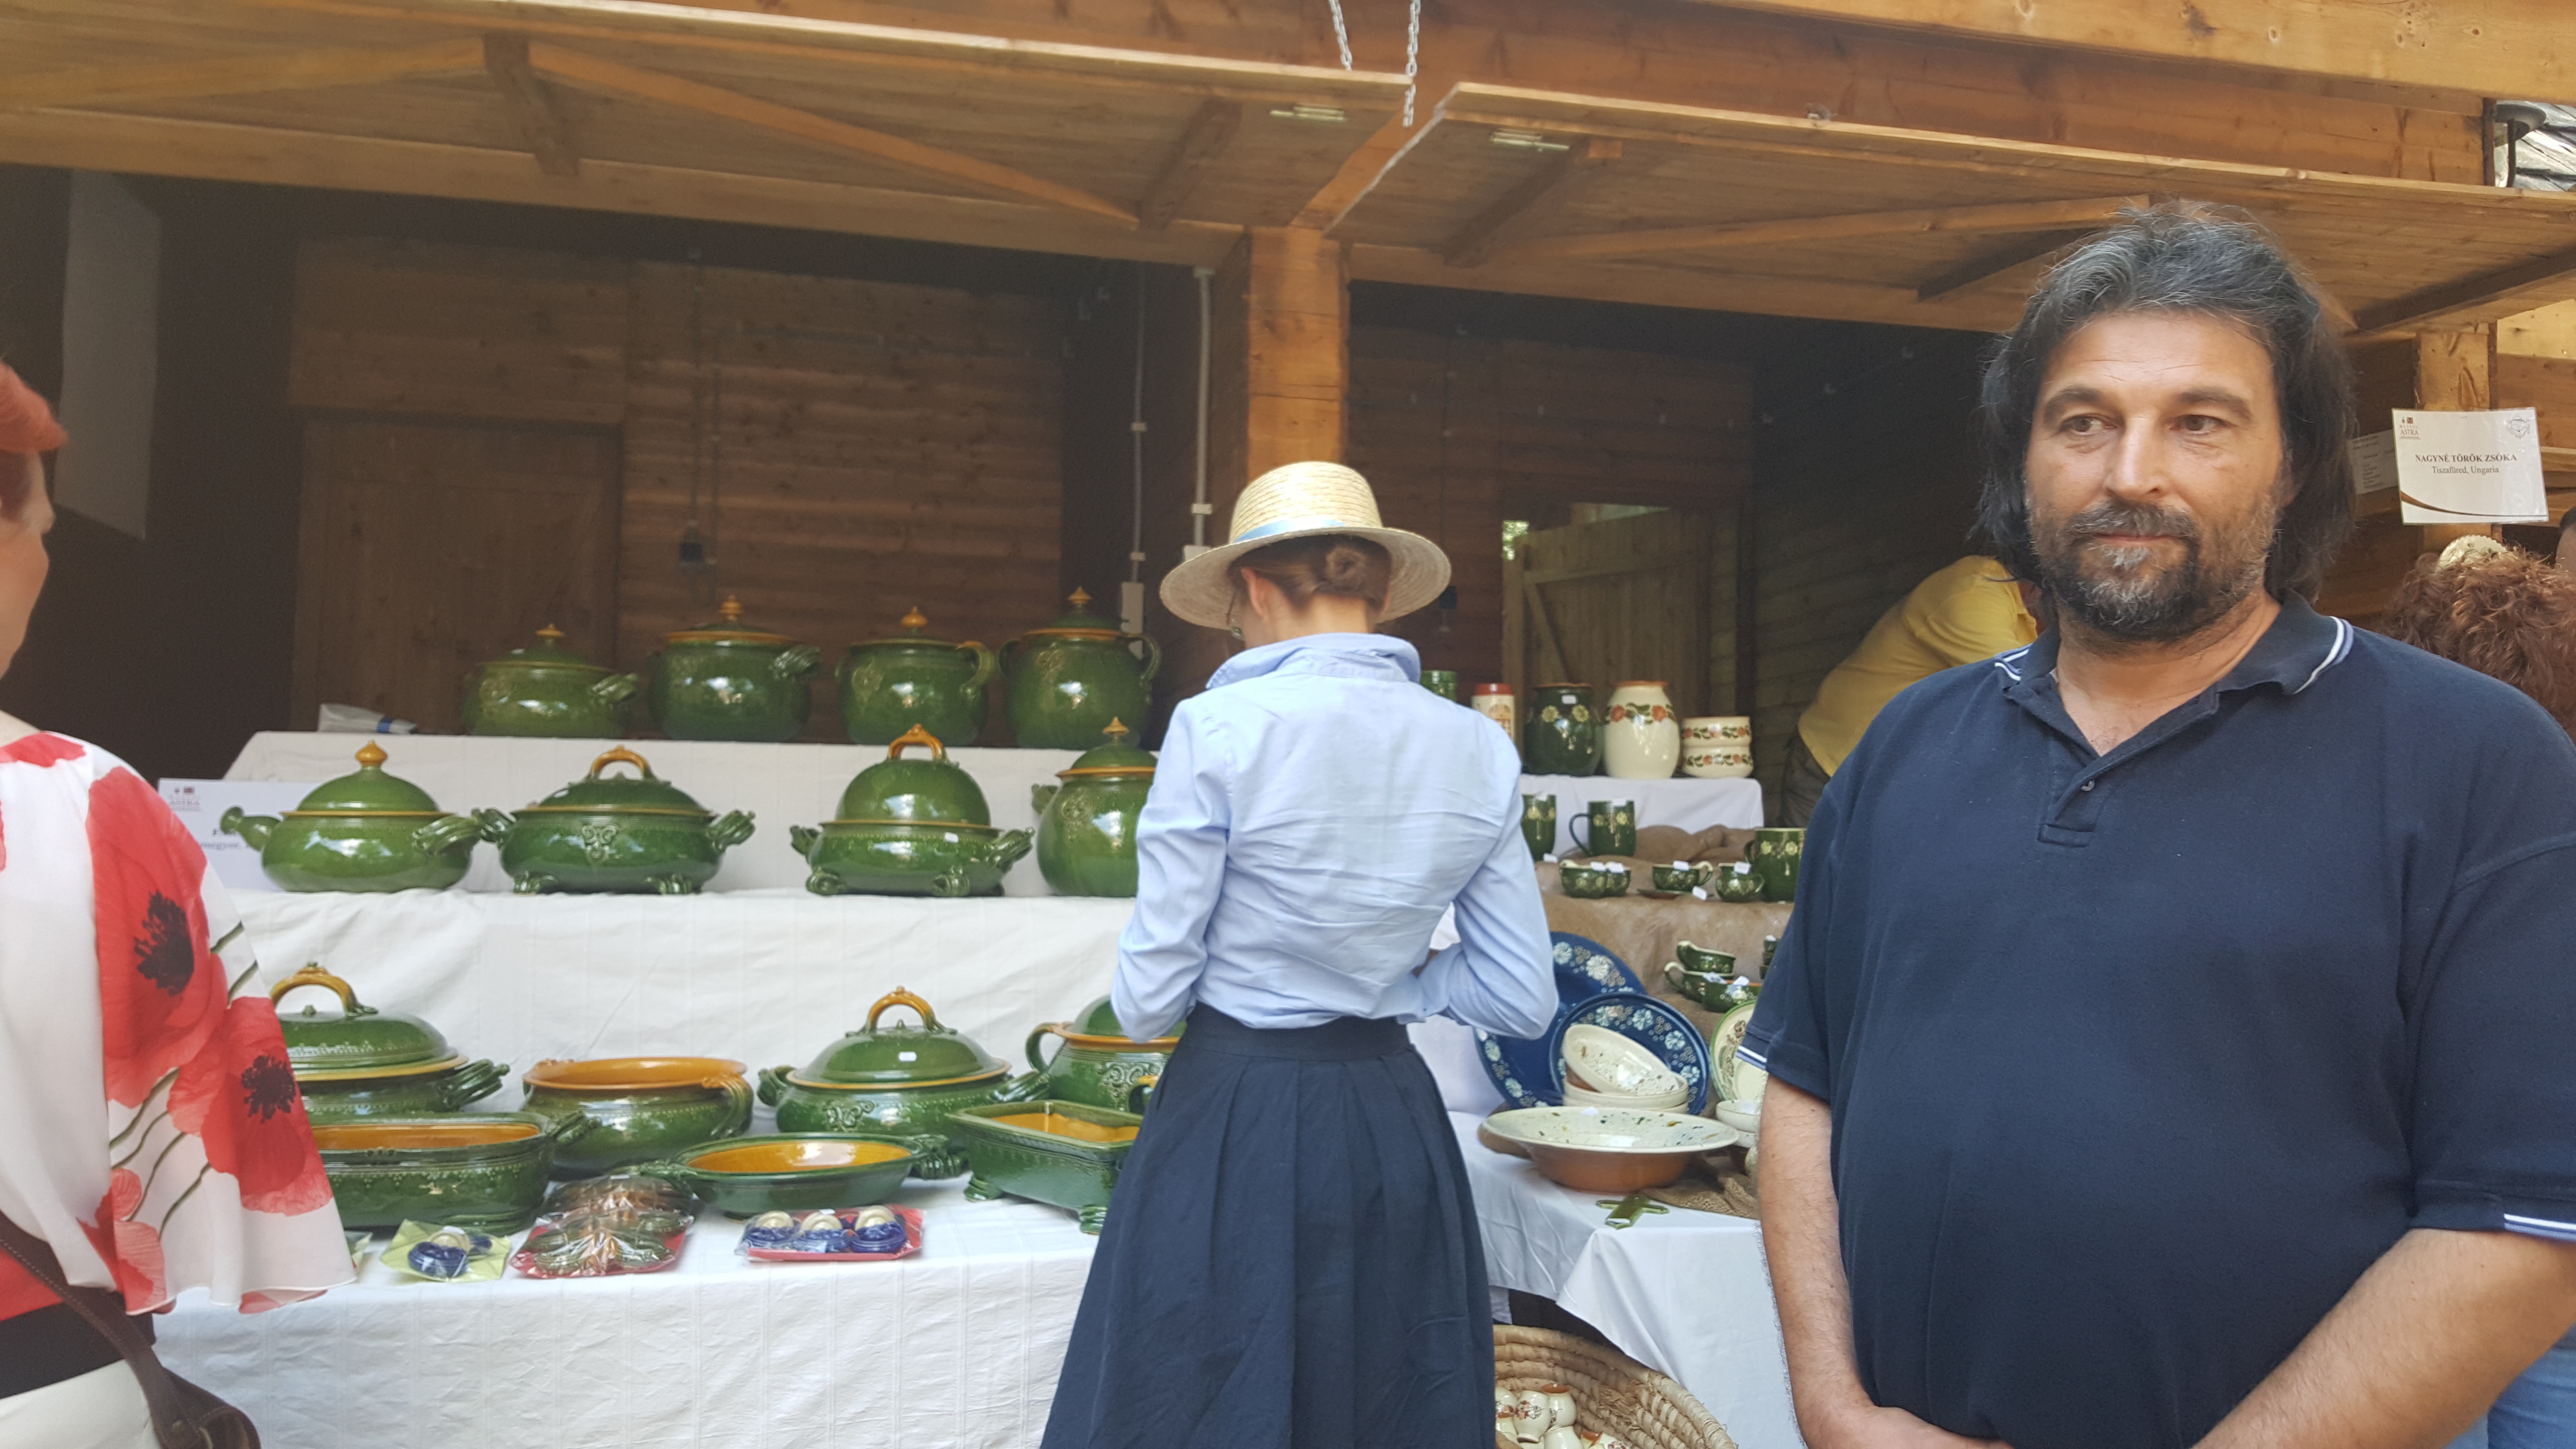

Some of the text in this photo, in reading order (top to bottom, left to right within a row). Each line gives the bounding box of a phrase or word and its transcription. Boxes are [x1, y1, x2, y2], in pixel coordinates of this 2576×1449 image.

[2415, 452, 2517, 462] NAGYNÉ TÖRÖK ZSÓKA
[2471, 466, 2499, 475] Ungaria
